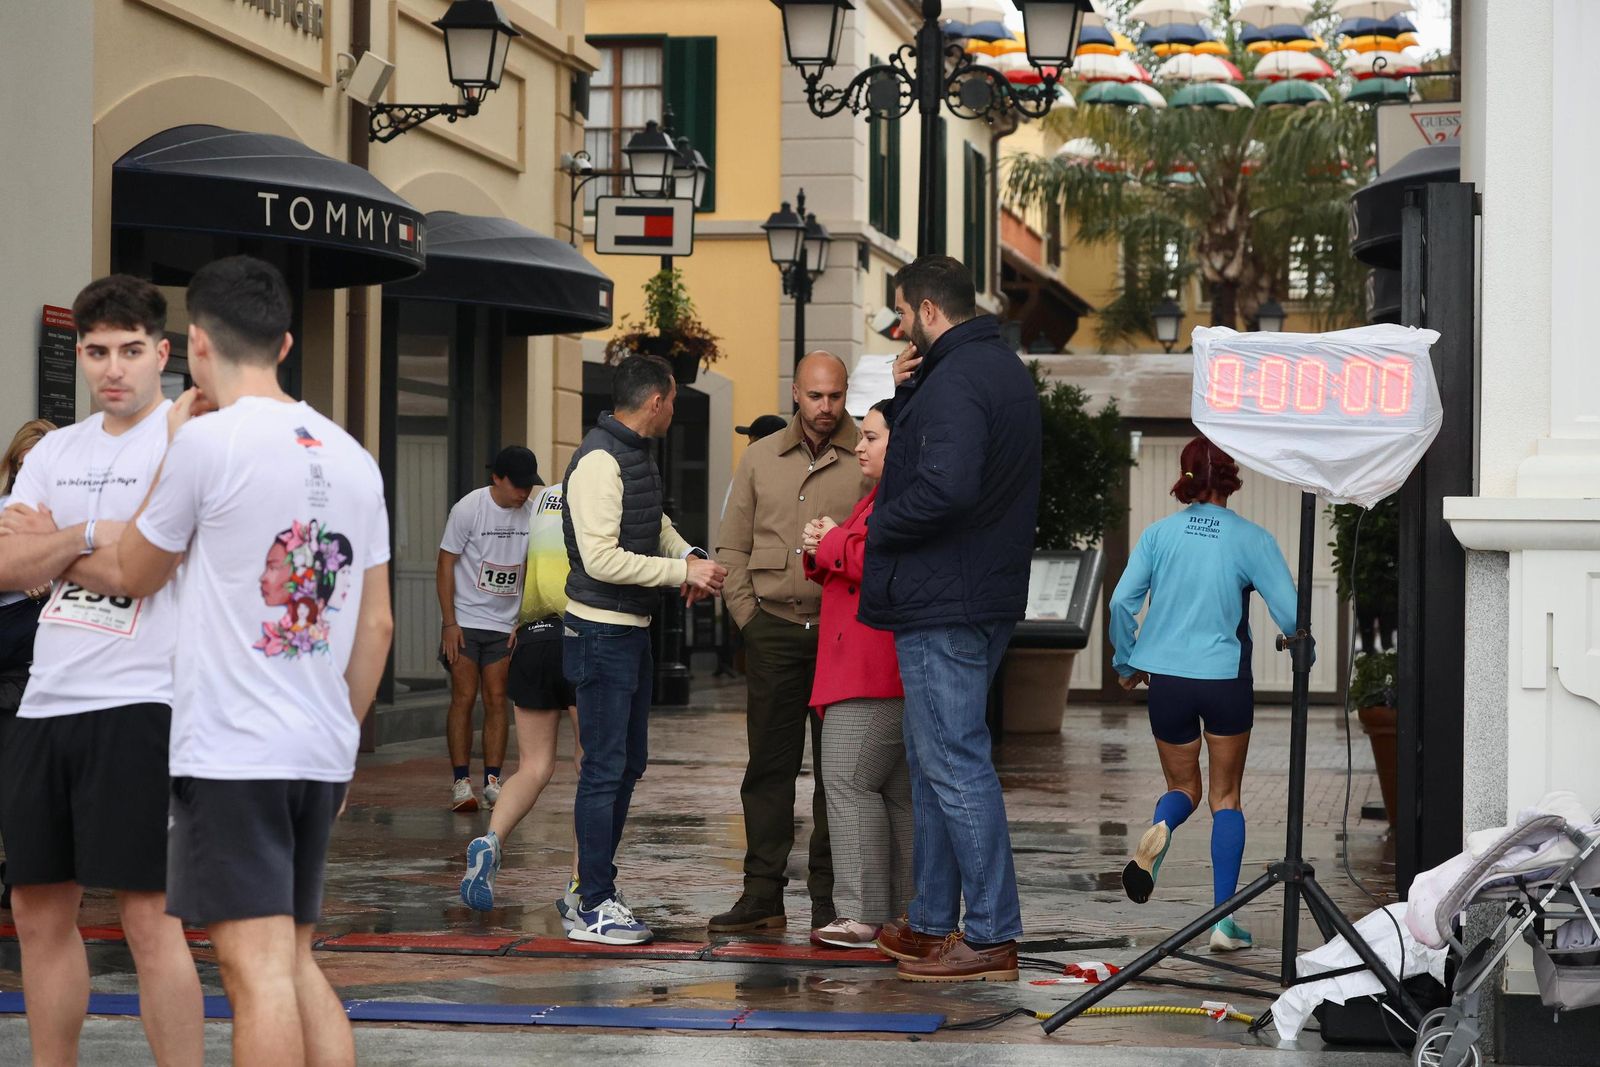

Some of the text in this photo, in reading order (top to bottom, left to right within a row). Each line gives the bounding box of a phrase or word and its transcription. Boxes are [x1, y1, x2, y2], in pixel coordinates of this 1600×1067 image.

[1420, 115, 1460, 127] GUESS
[257, 191, 392, 244] TOMMY
[1208, 355, 1411, 414] 0:00:00
[544, 502, 563, 511] TRI
[1189, 516, 1220, 527] nerja
[1186, 525, 1220, 533] ATLETISMO
[485, 569, 517, 585] 189
